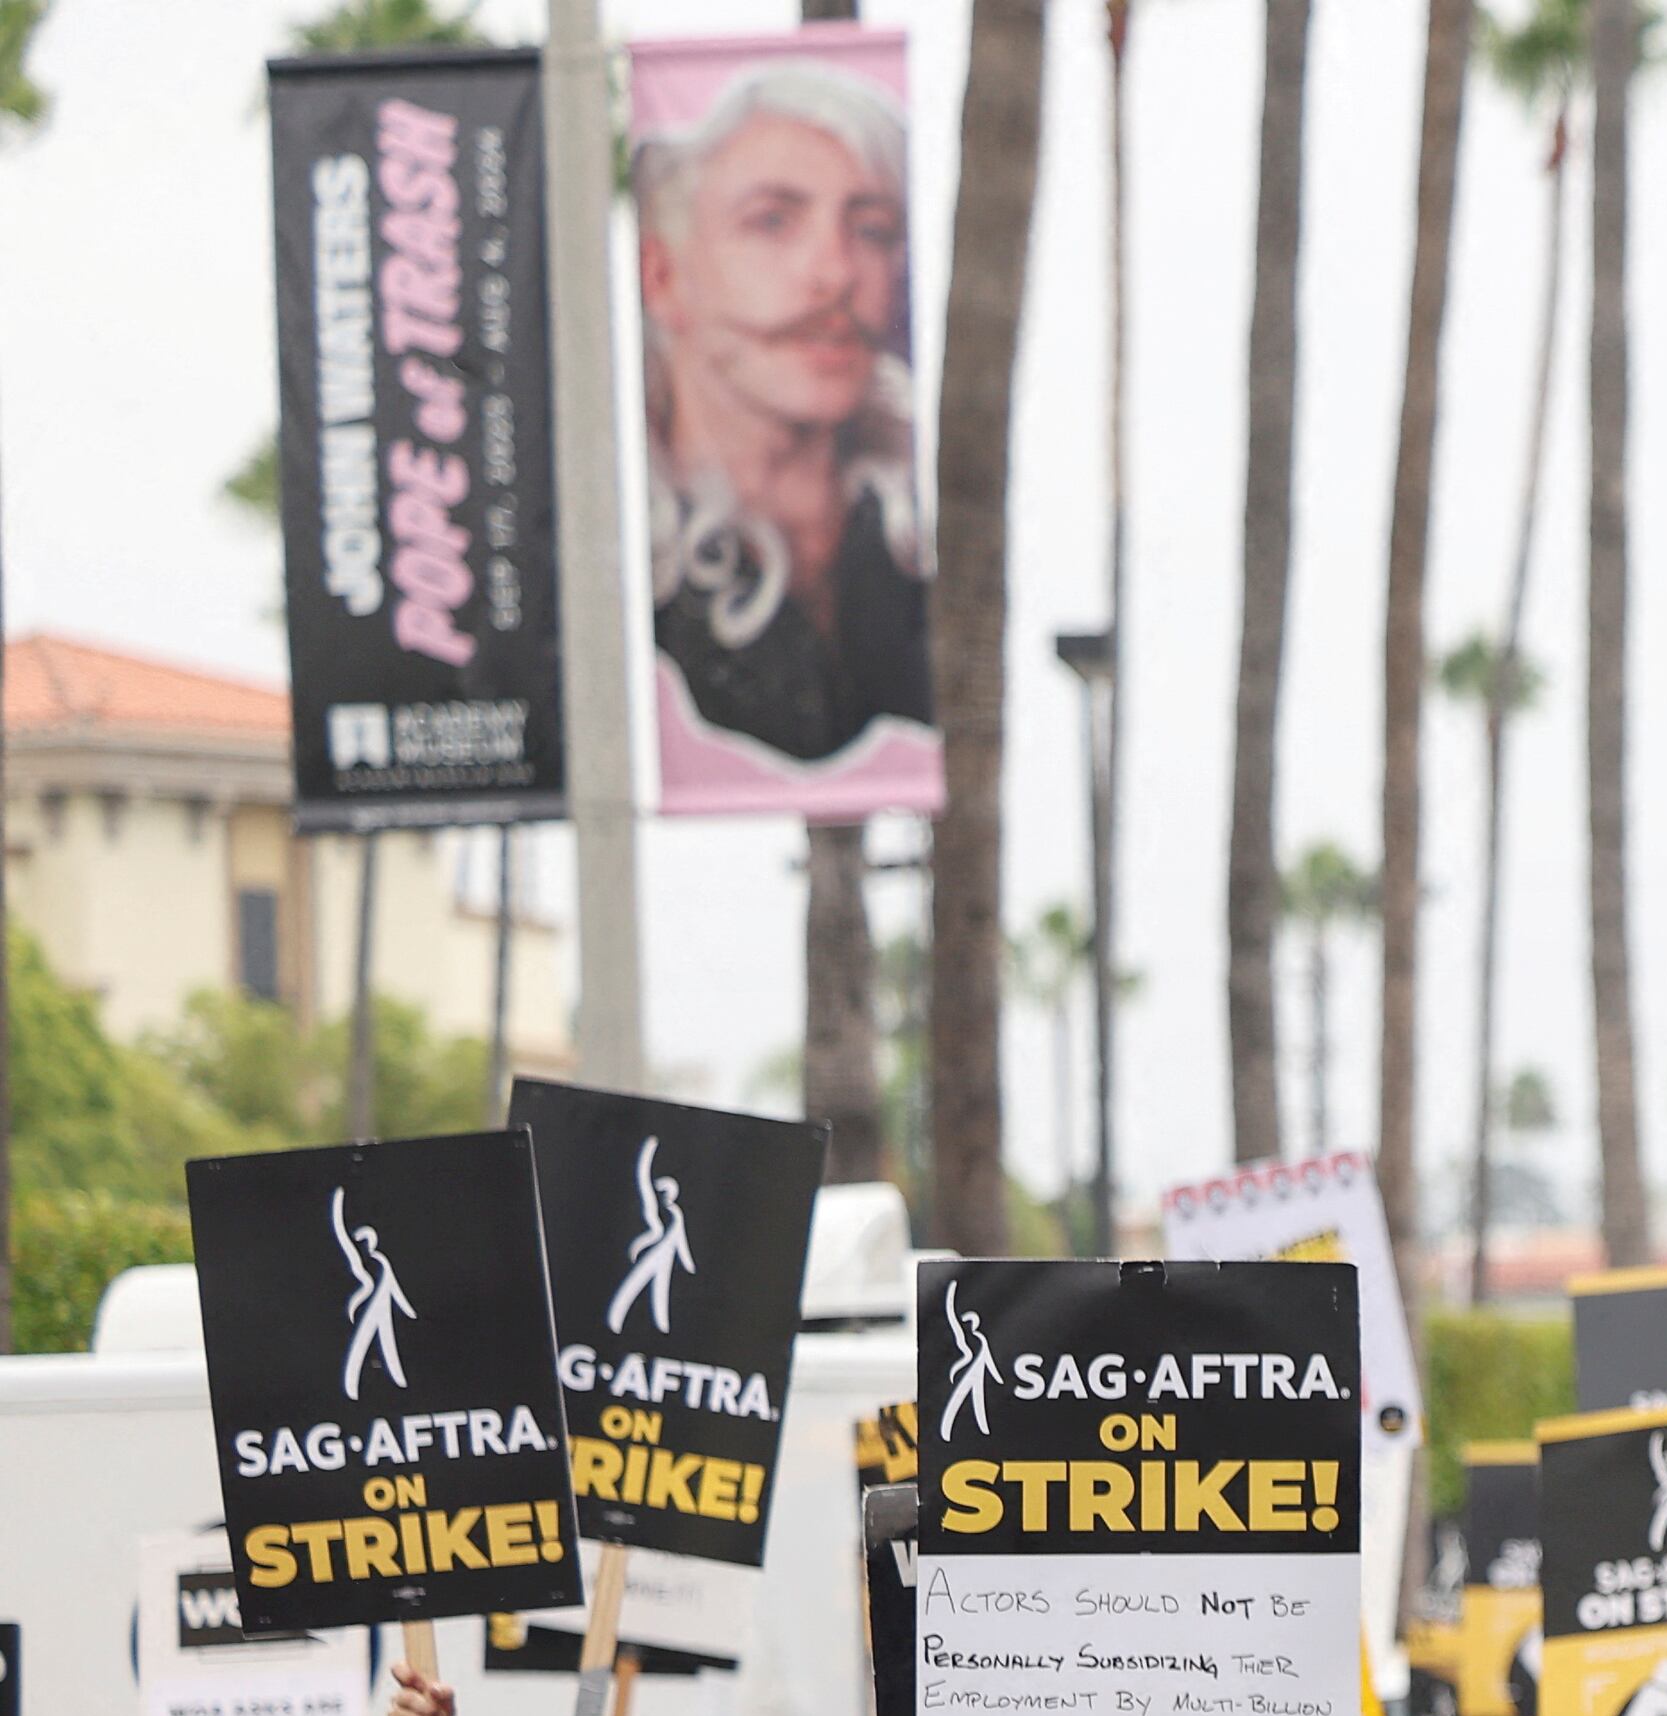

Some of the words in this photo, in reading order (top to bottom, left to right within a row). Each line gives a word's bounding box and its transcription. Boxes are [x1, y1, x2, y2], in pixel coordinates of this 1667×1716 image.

[377, 97, 465, 356] TRASH
[312, 153, 376, 424] WATERS
[319, 425, 384, 616] JOHN
[388, 438, 479, 667] POPE
[558, 1343, 771, 1422] G·AFTRA
[600, 1404, 664, 1445] ON
[1098, 1413, 1177, 1452] ON
[363, 1473, 428, 1512] ON
[567, 1434, 766, 1525] RIKE!
[940, 1459, 1340, 1533] STRIKE!
[244, 1500, 565, 1588] STRIKE!
[924, 1566, 1051, 1617] ACTORS
[1075, 1588, 1180, 1617] SHOULD
[1200, 1592, 1256, 1620] NOT
[1271, 1594, 1312, 1618] BE
[1576, 1591, 1636, 1630] ON
[923, 1633, 1065, 1674] PERSONALLY
[1076, 1643, 1219, 1679] SUBSIDIZING
[923, 1679, 1098, 1710] EMPLOYMENT
